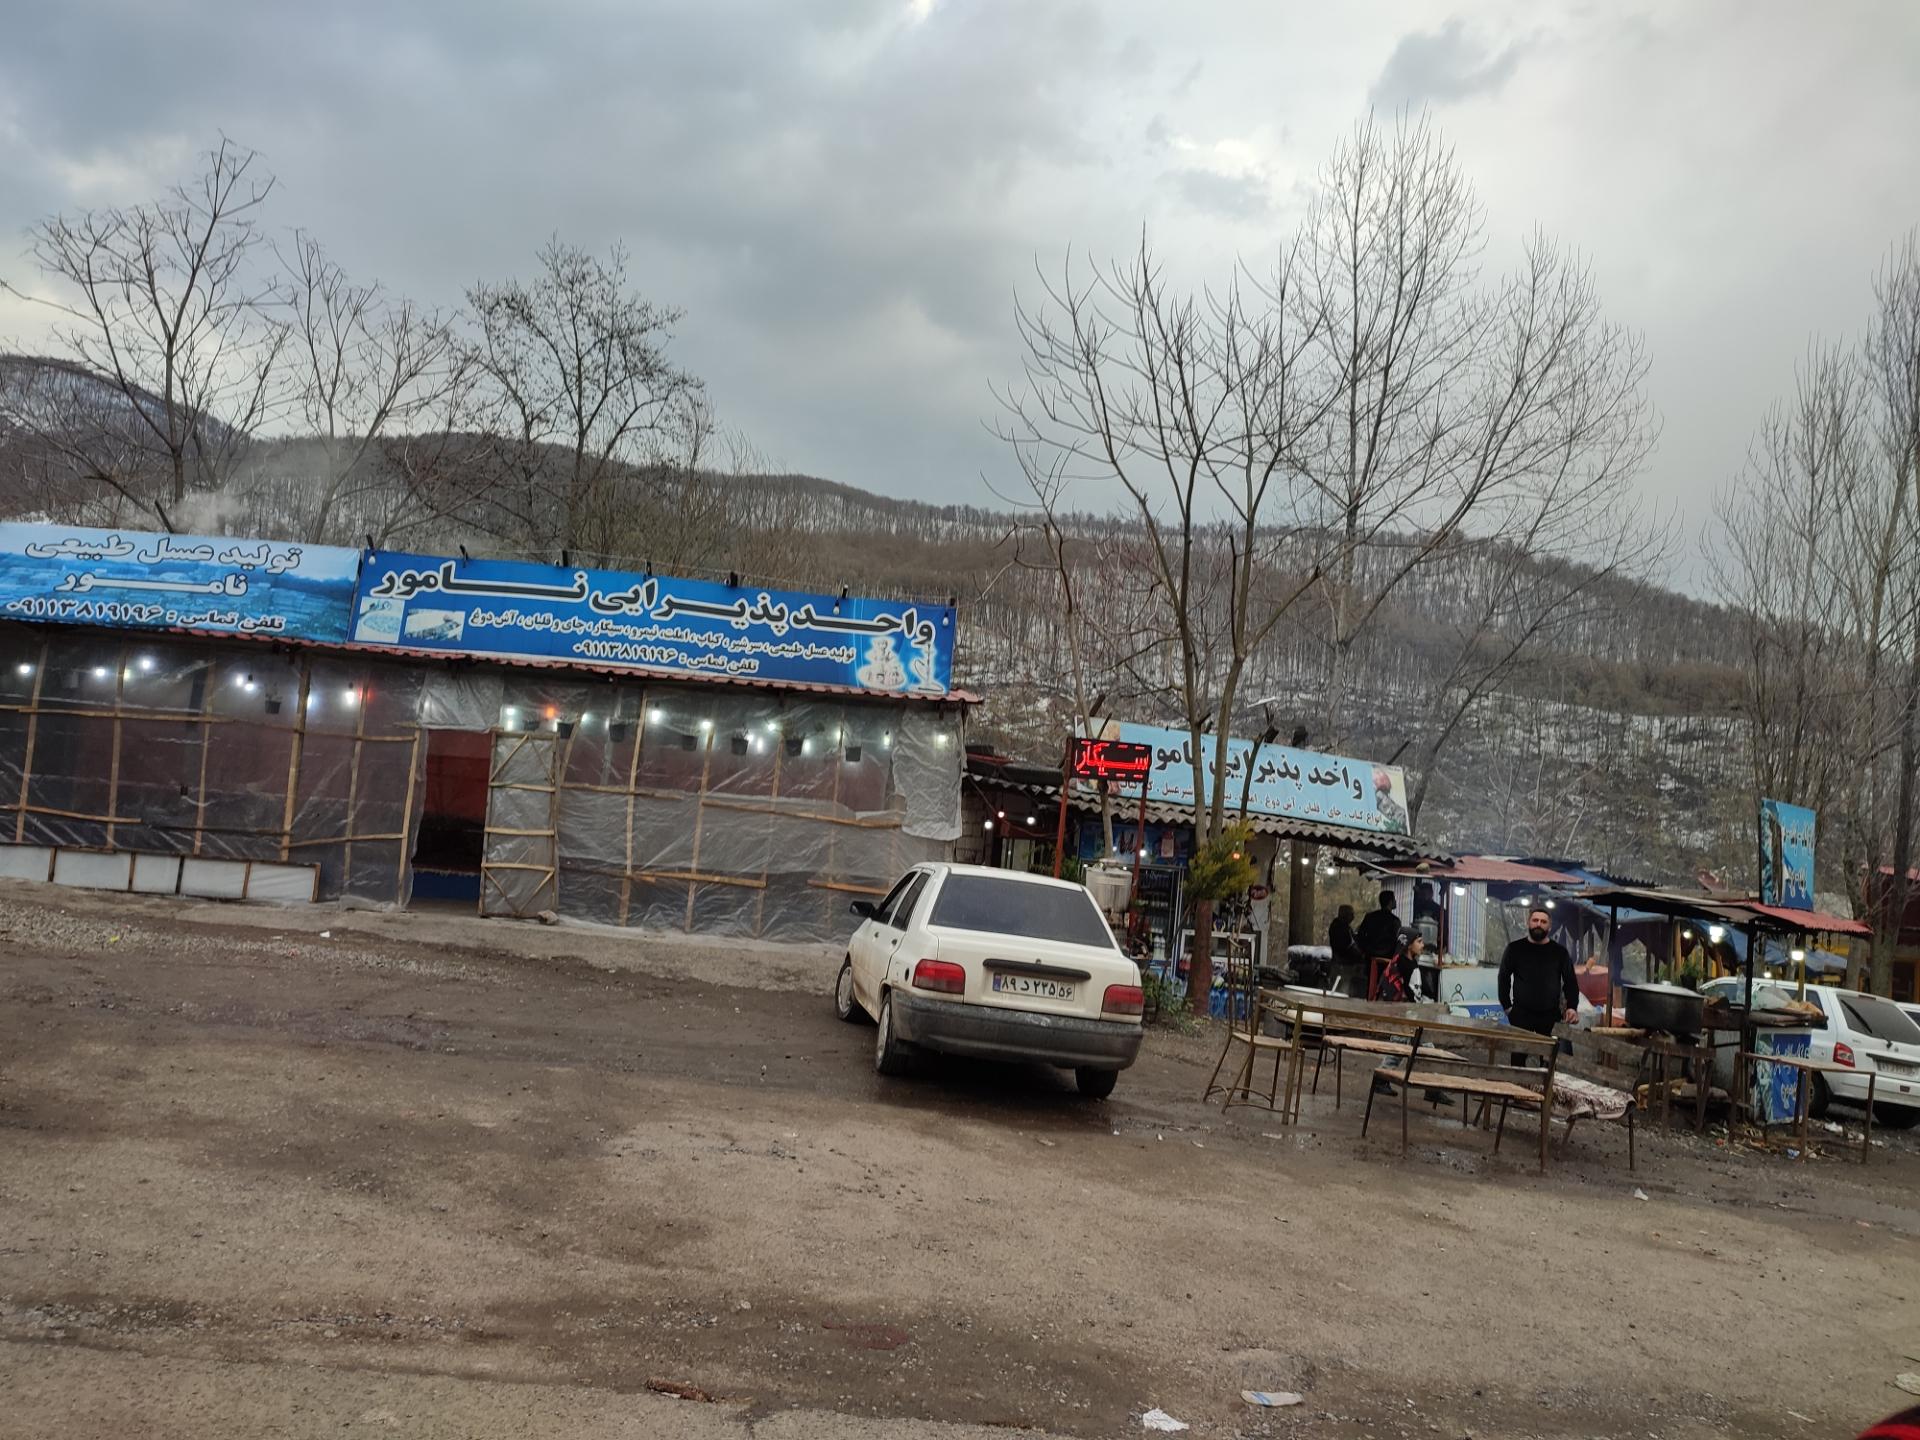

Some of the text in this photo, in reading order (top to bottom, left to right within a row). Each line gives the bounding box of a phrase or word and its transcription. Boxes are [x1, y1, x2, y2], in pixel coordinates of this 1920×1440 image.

[25, 534, 303, 574] تولید عسل طبیعی
[53, 571, 249, 596] نامور
[370, 561, 935, 648] واحد پذیرایی نامور
[239, 614, 285, 632] تلفن
[469, 607, 494, 627] دوغ
[494, 609, 519, 627] آش
[561, 616, 585, 634] چای
[803, 642, 828, 659] عسل
[829, 645, 856, 664] تولید
[727, 658, 759, 673] تلفن
[1076, 743, 1149, 773] سیگار
[1307, 765, 1363, 799] واحد
